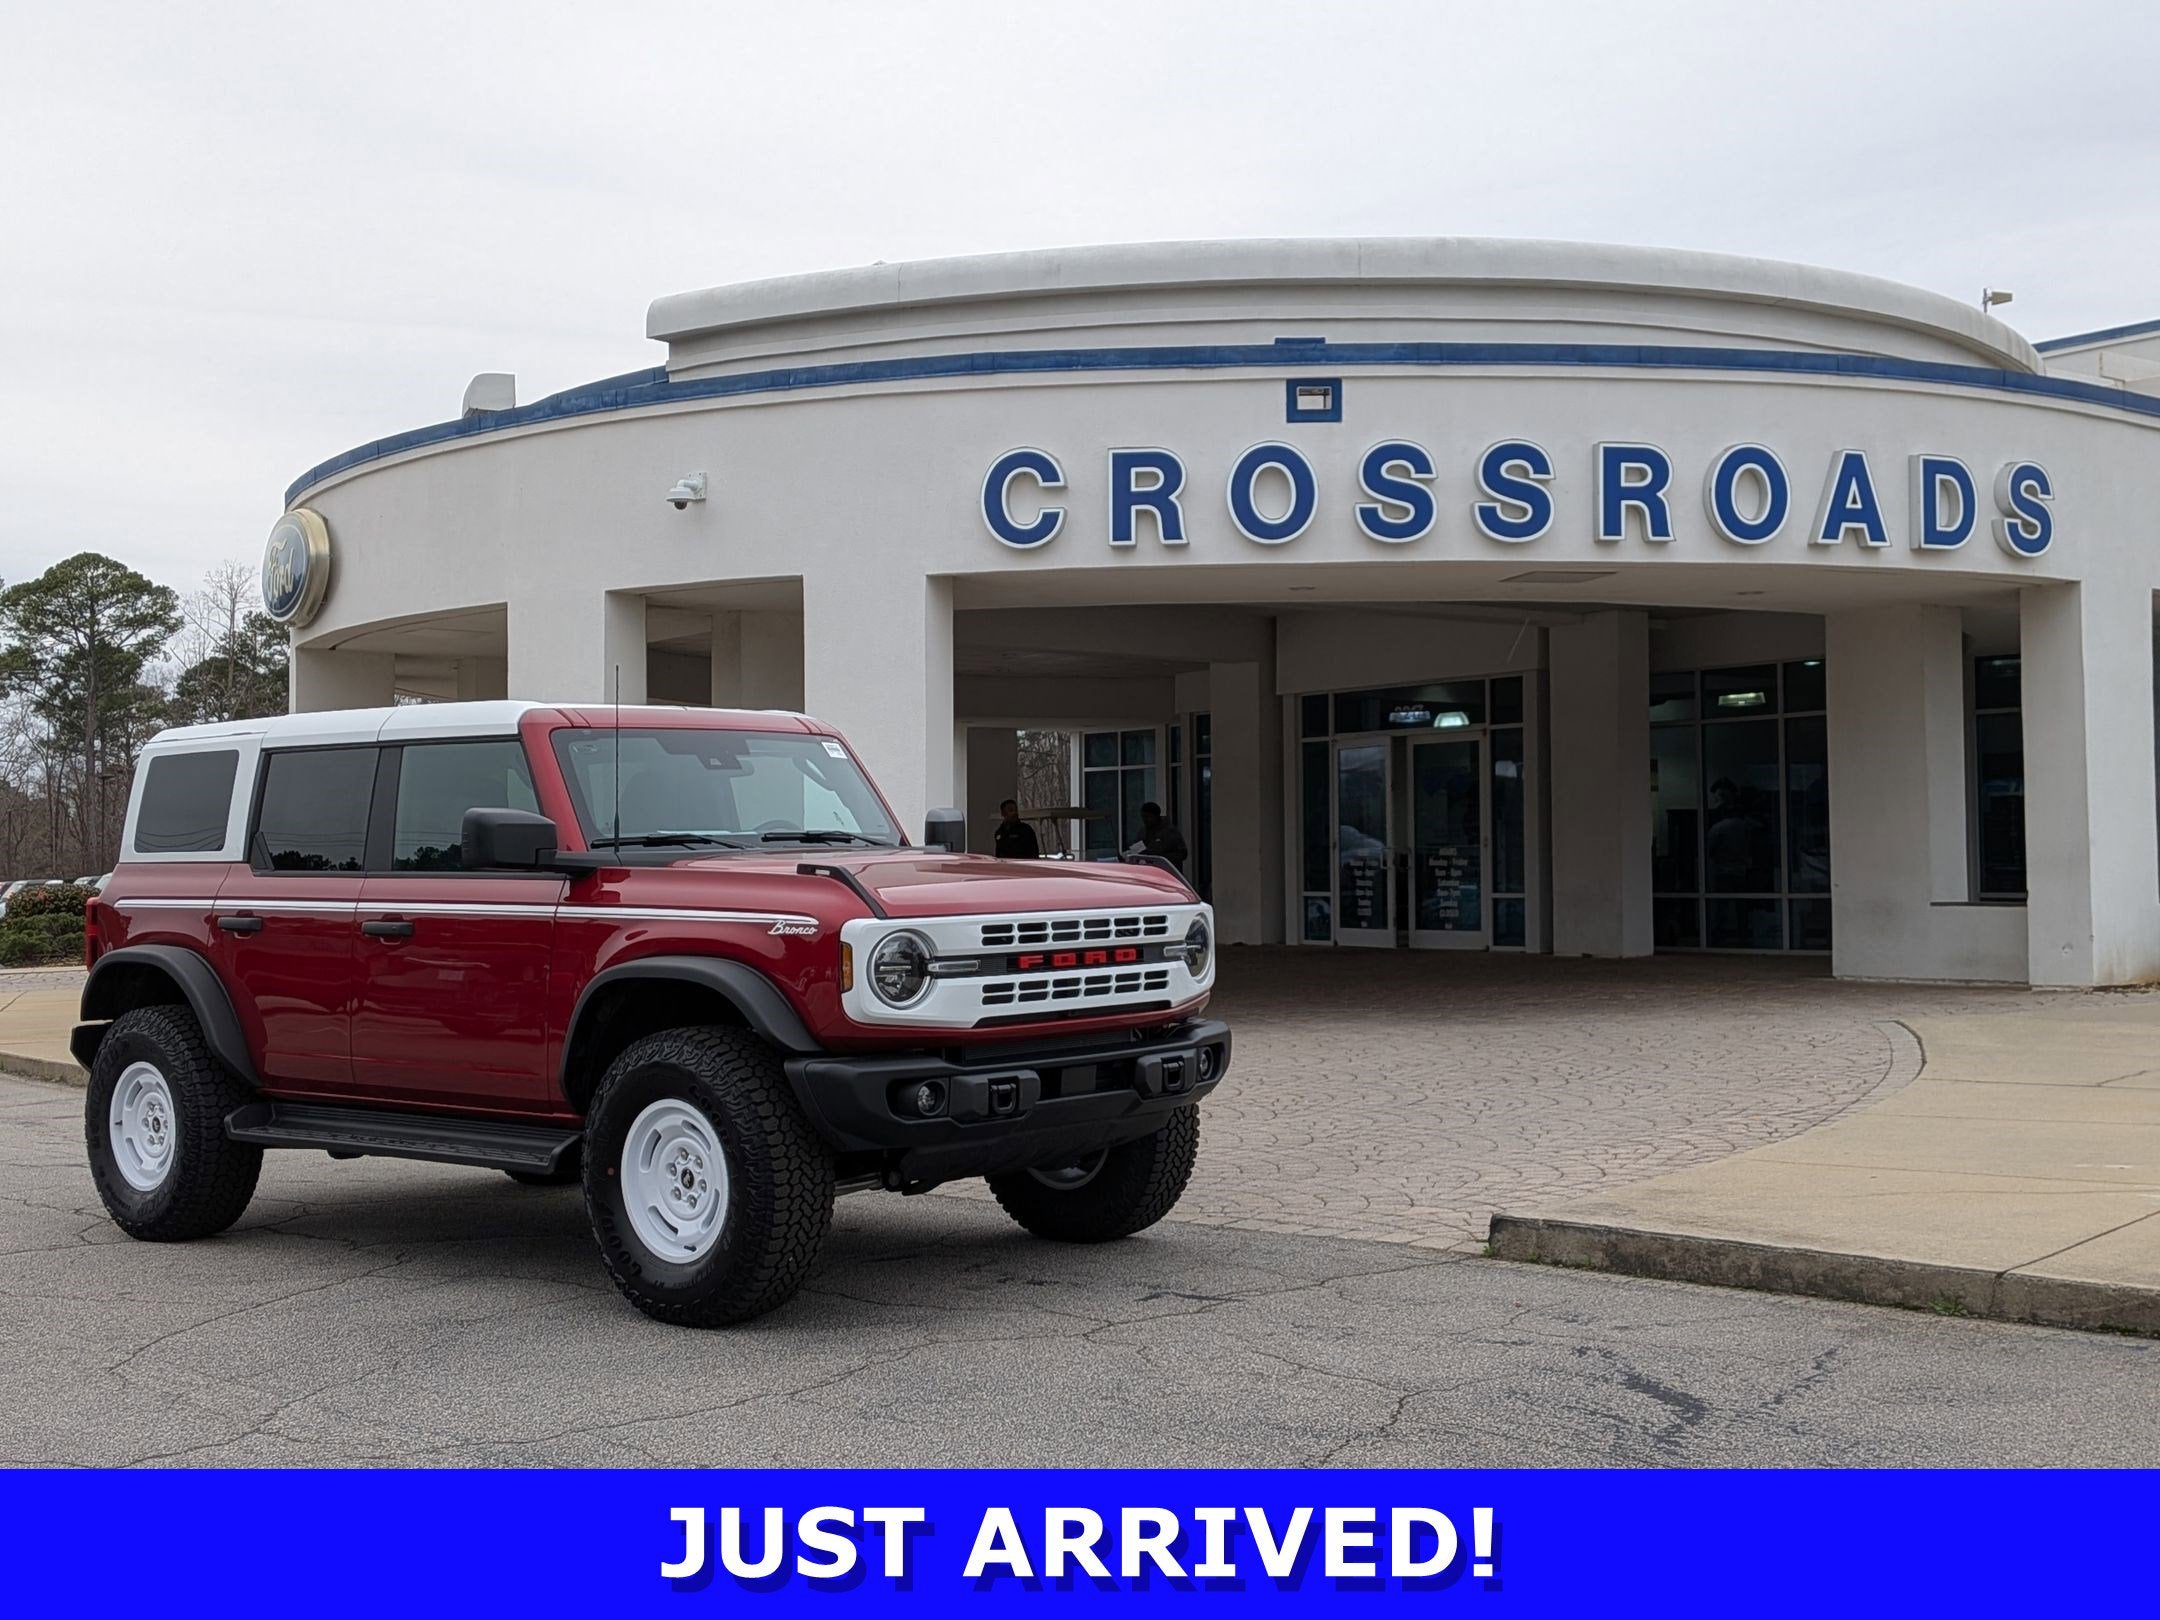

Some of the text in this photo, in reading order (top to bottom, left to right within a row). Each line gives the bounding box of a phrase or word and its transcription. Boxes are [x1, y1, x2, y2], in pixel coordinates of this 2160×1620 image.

[980, 437, 2056, 558] CROSSROADS
[267, 538, 295, 600] Ford
[767, 919, 818, 935] Bronco
[1018, 947, 1137, 970] FORD
